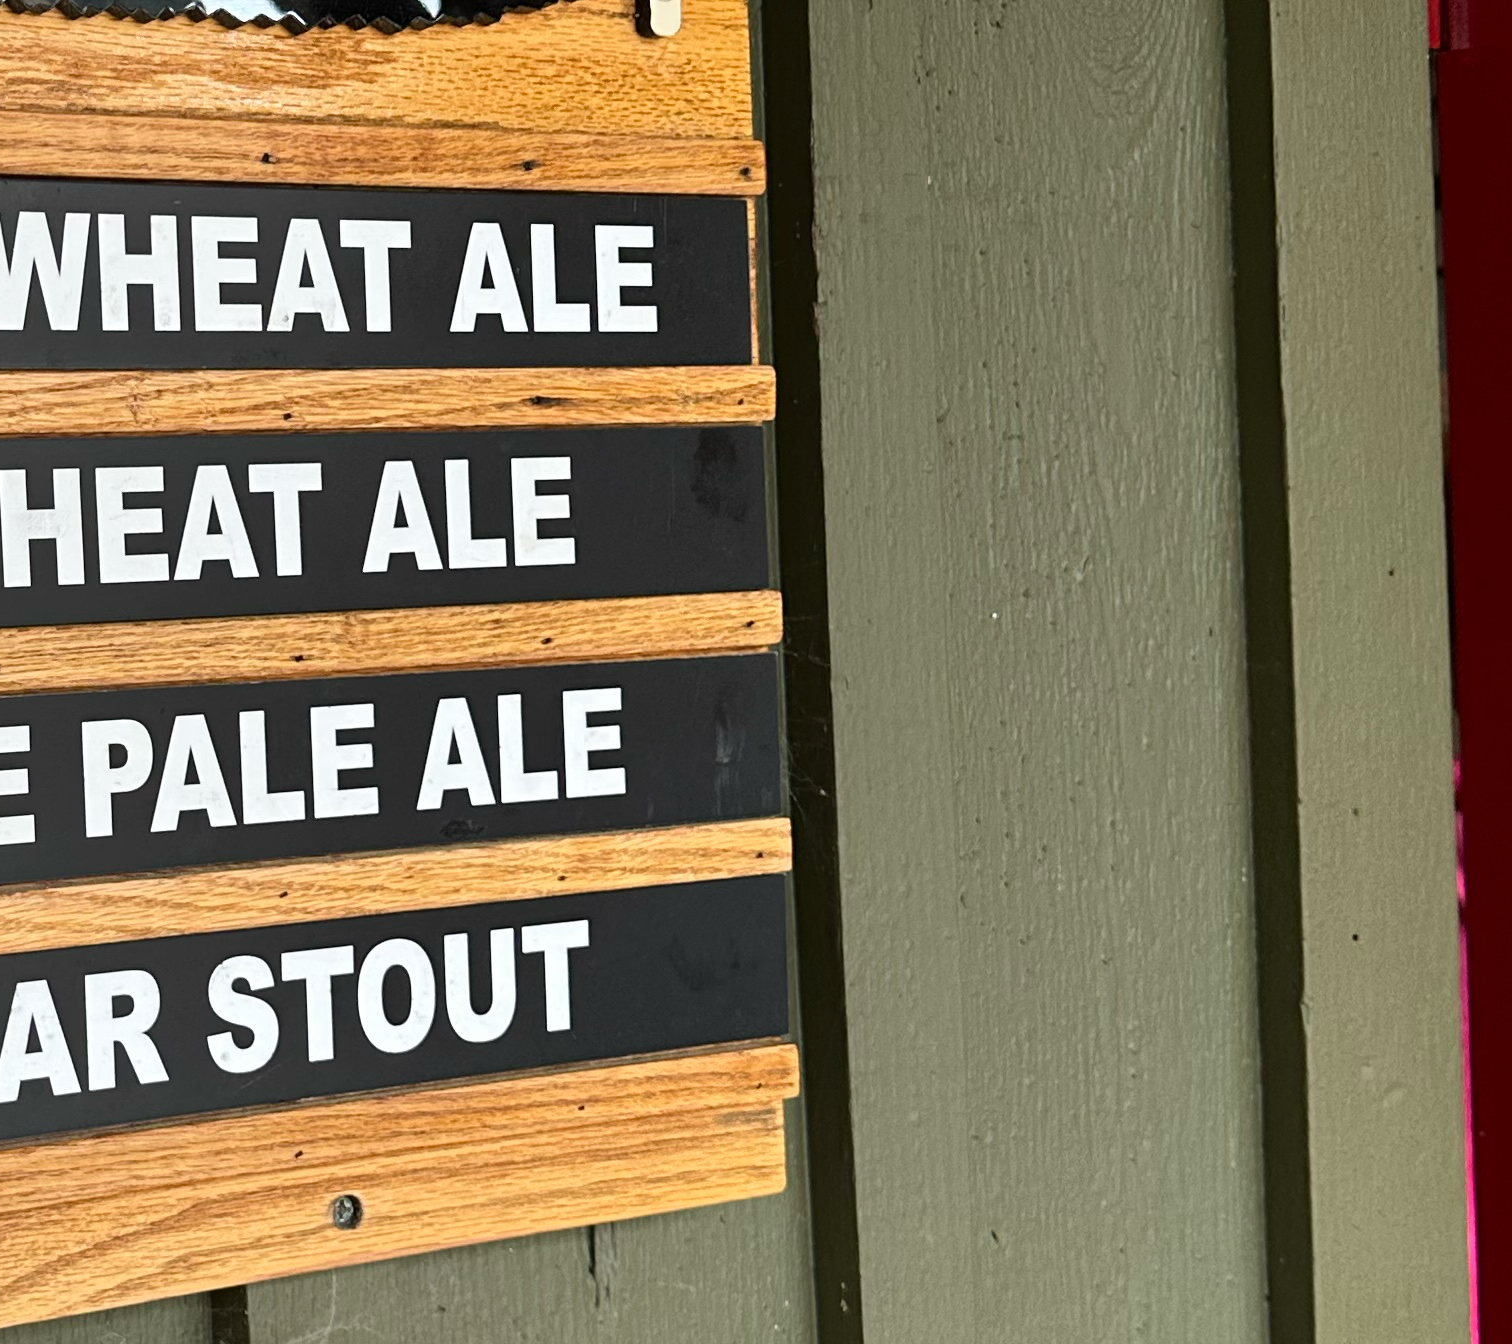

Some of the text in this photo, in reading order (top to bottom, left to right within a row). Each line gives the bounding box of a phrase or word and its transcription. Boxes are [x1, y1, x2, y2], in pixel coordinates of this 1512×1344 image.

[449, 223, 658, 333] ALE
[362, 456, 576, 573] ALE
[81, 703, 380, 838] PALE
[416, 687, 627, 811] ALE
[206, 919, 590, 1074] STOUT
